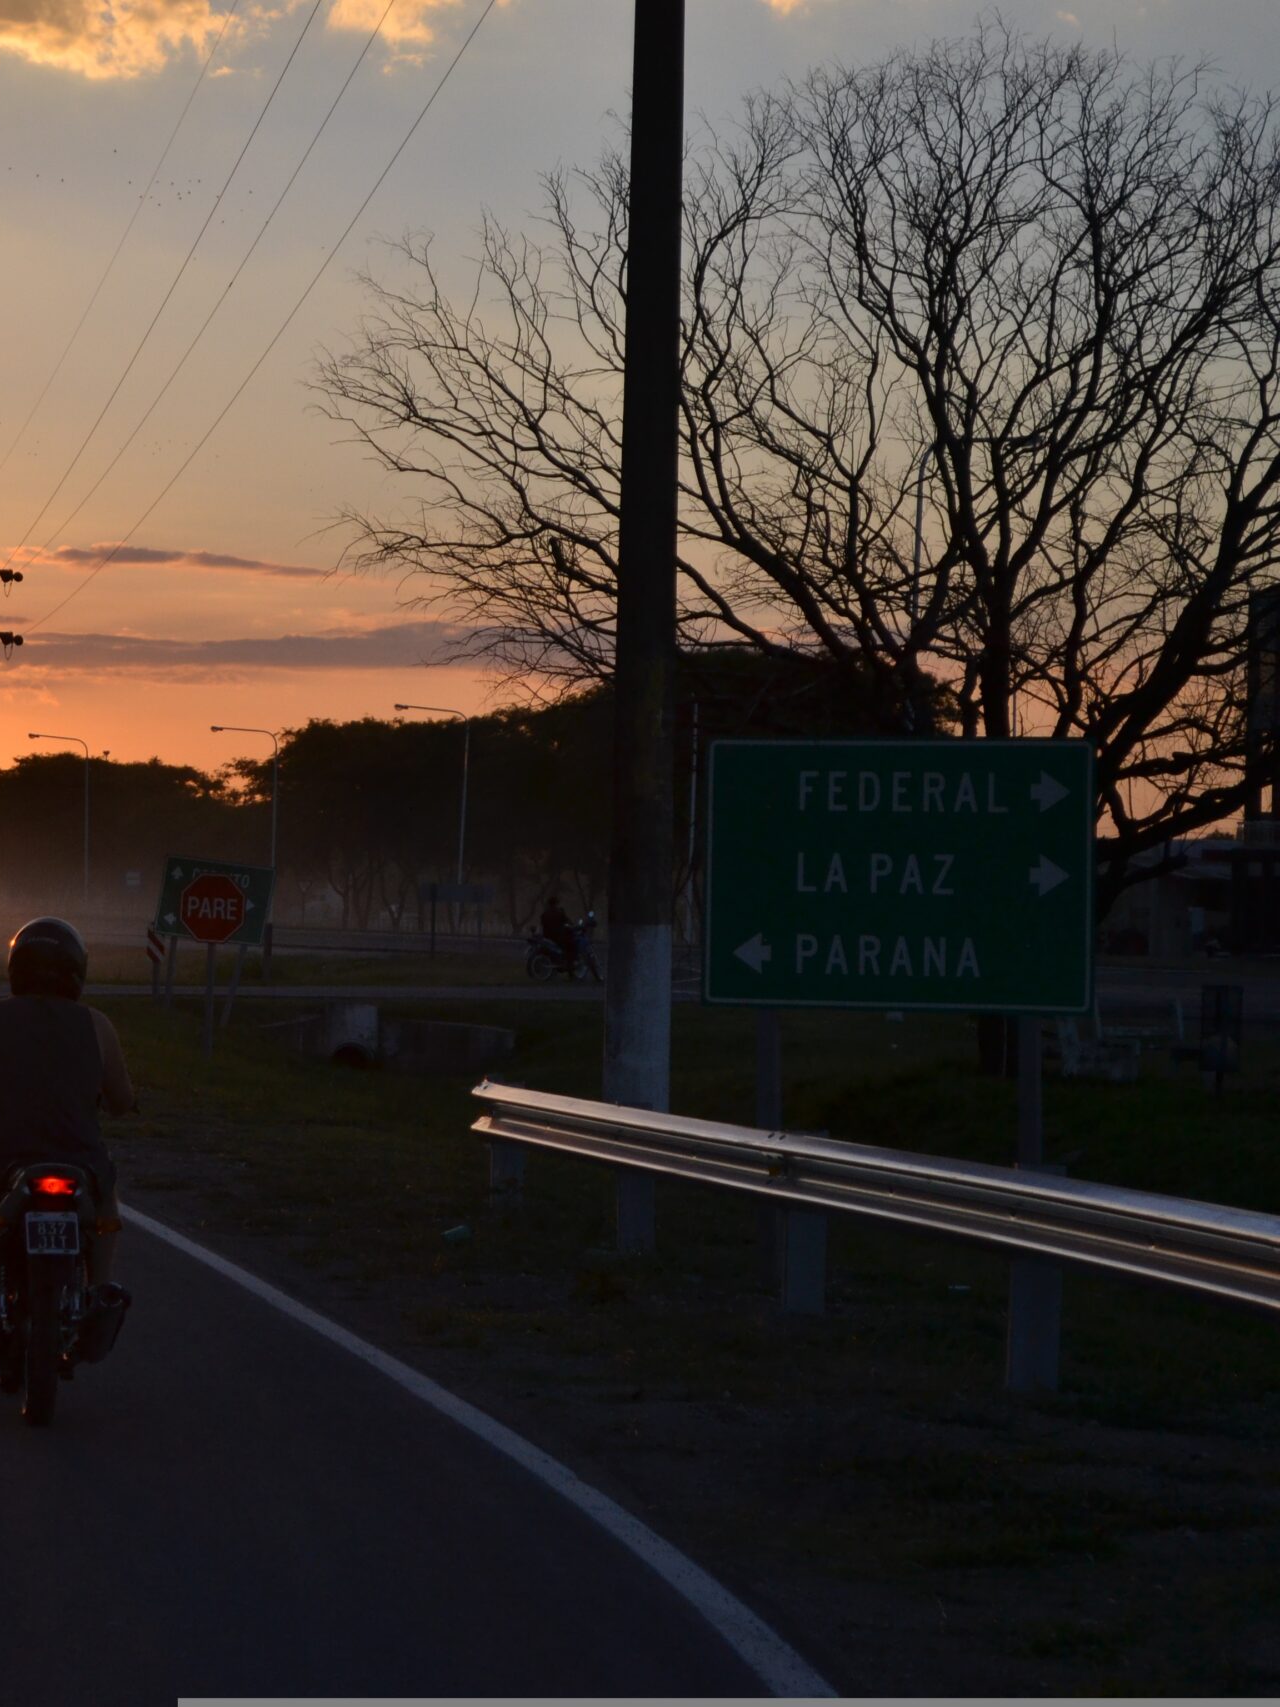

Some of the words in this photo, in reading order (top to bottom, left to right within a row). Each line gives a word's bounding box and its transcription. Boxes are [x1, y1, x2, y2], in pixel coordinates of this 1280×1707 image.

[798, 769, 1010, 814] FEDERAL
[796, 851, 849, 894] LA
[869, 852, 956, 896] PAZ
[187, 895, 239, 921] PARE
[795, 933, 982, 979] PARANA
